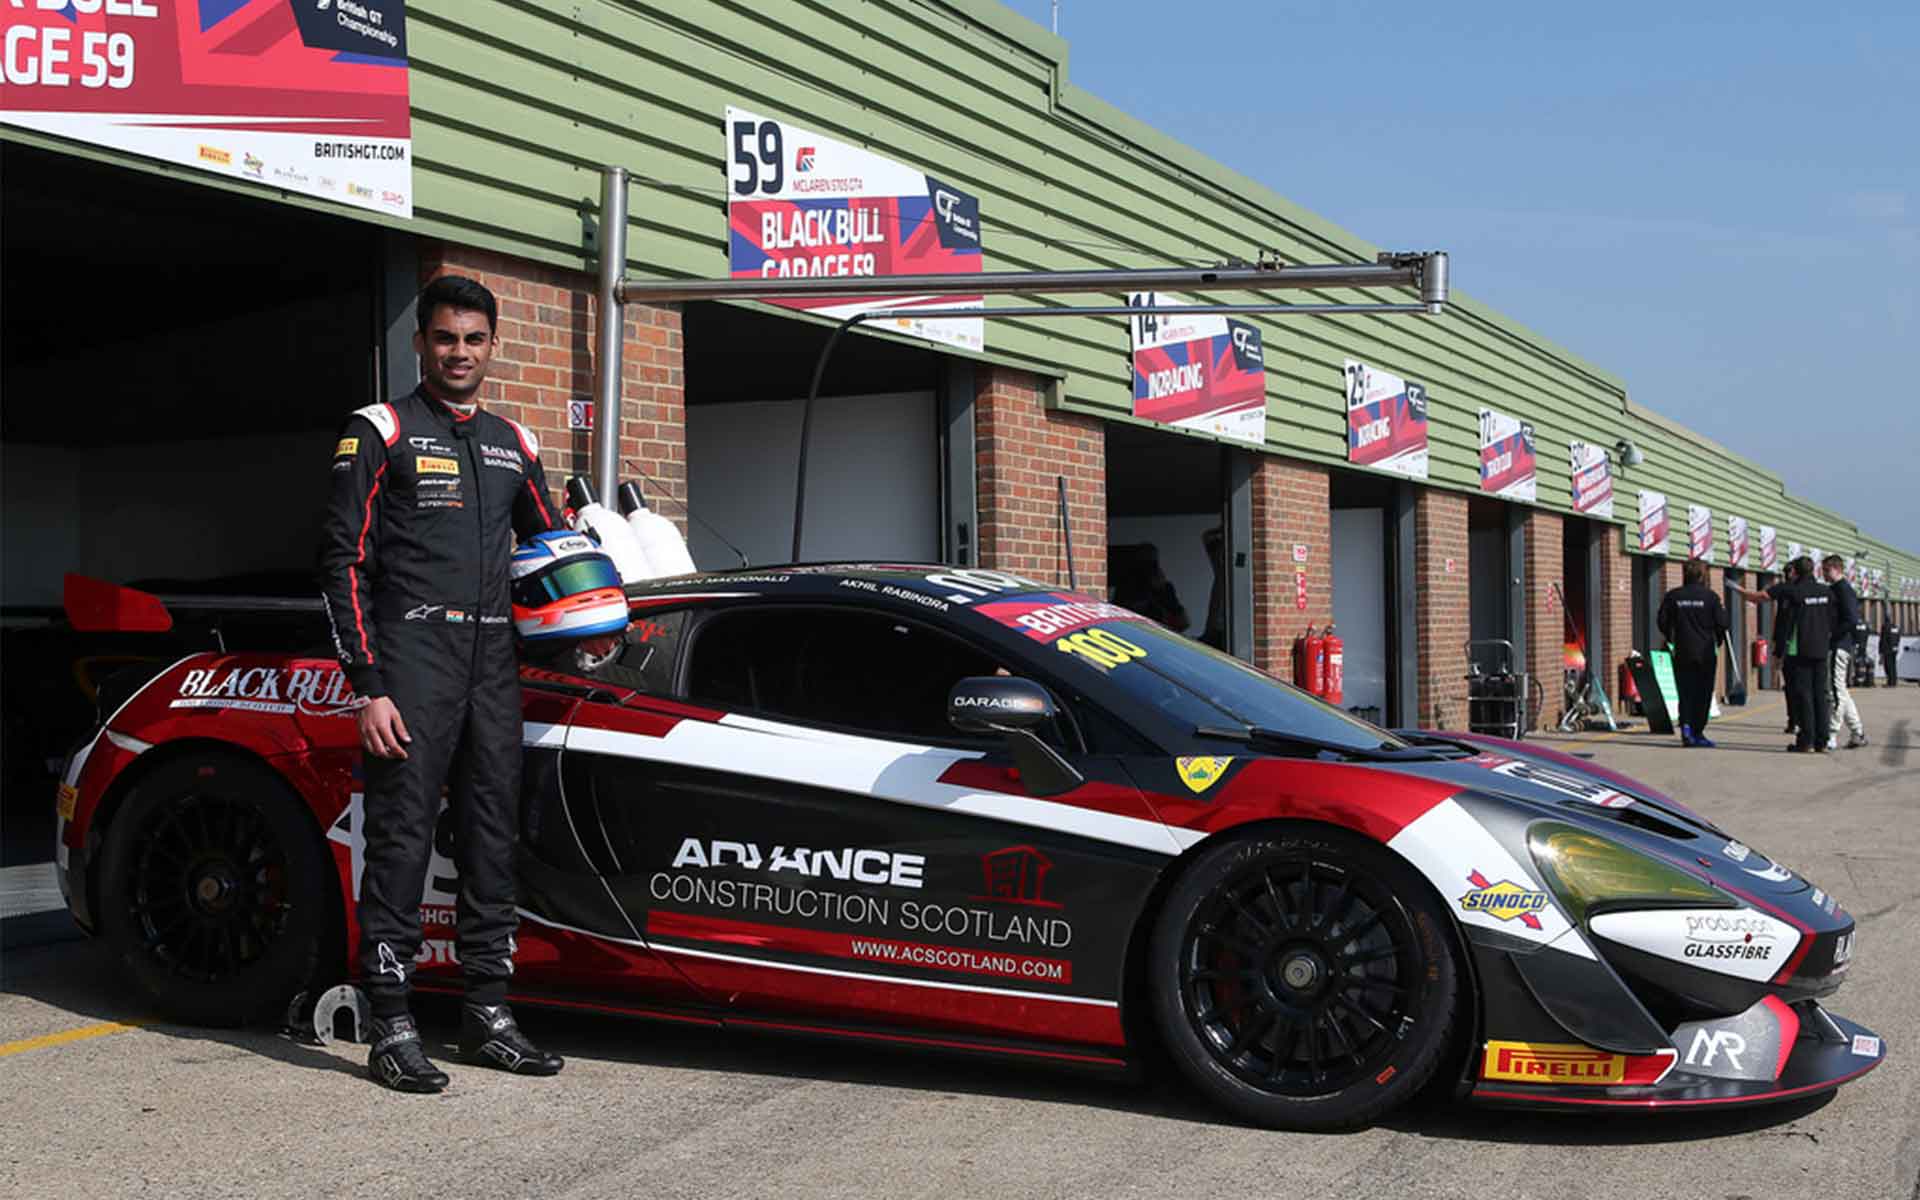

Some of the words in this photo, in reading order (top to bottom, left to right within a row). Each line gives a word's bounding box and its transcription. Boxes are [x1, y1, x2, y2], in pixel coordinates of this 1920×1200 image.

[0, 25, 71, 86] GE
[80, 32, 135, 88] 59
[314, 142, 405, 160] BRITISHGT.COM
[733, 120, 784, 196] 59
[761, 209, 833, 250] BLACK
[836, 207, 884, 246] BULL
[882, 586, 949, 612] RABINDRA
[1056, 628, 1147, 669] 100
[178, 667, 280, 700] BLACK
[672, 838, 926, 888] ADVANCE
[650, 873, 888, 925] CONSTRUCTION
[900, 902, 1071, 948] SCOTLAND
[1467, 893, 1546, 909] SUNOCO
[851, 940, 1063, 979] WWW.ACSCOTLAND.COM
[1684, 943, 1772, 960] GLASSFIBRE
[1497, 1048, 1612, 1077] PIRELLI
